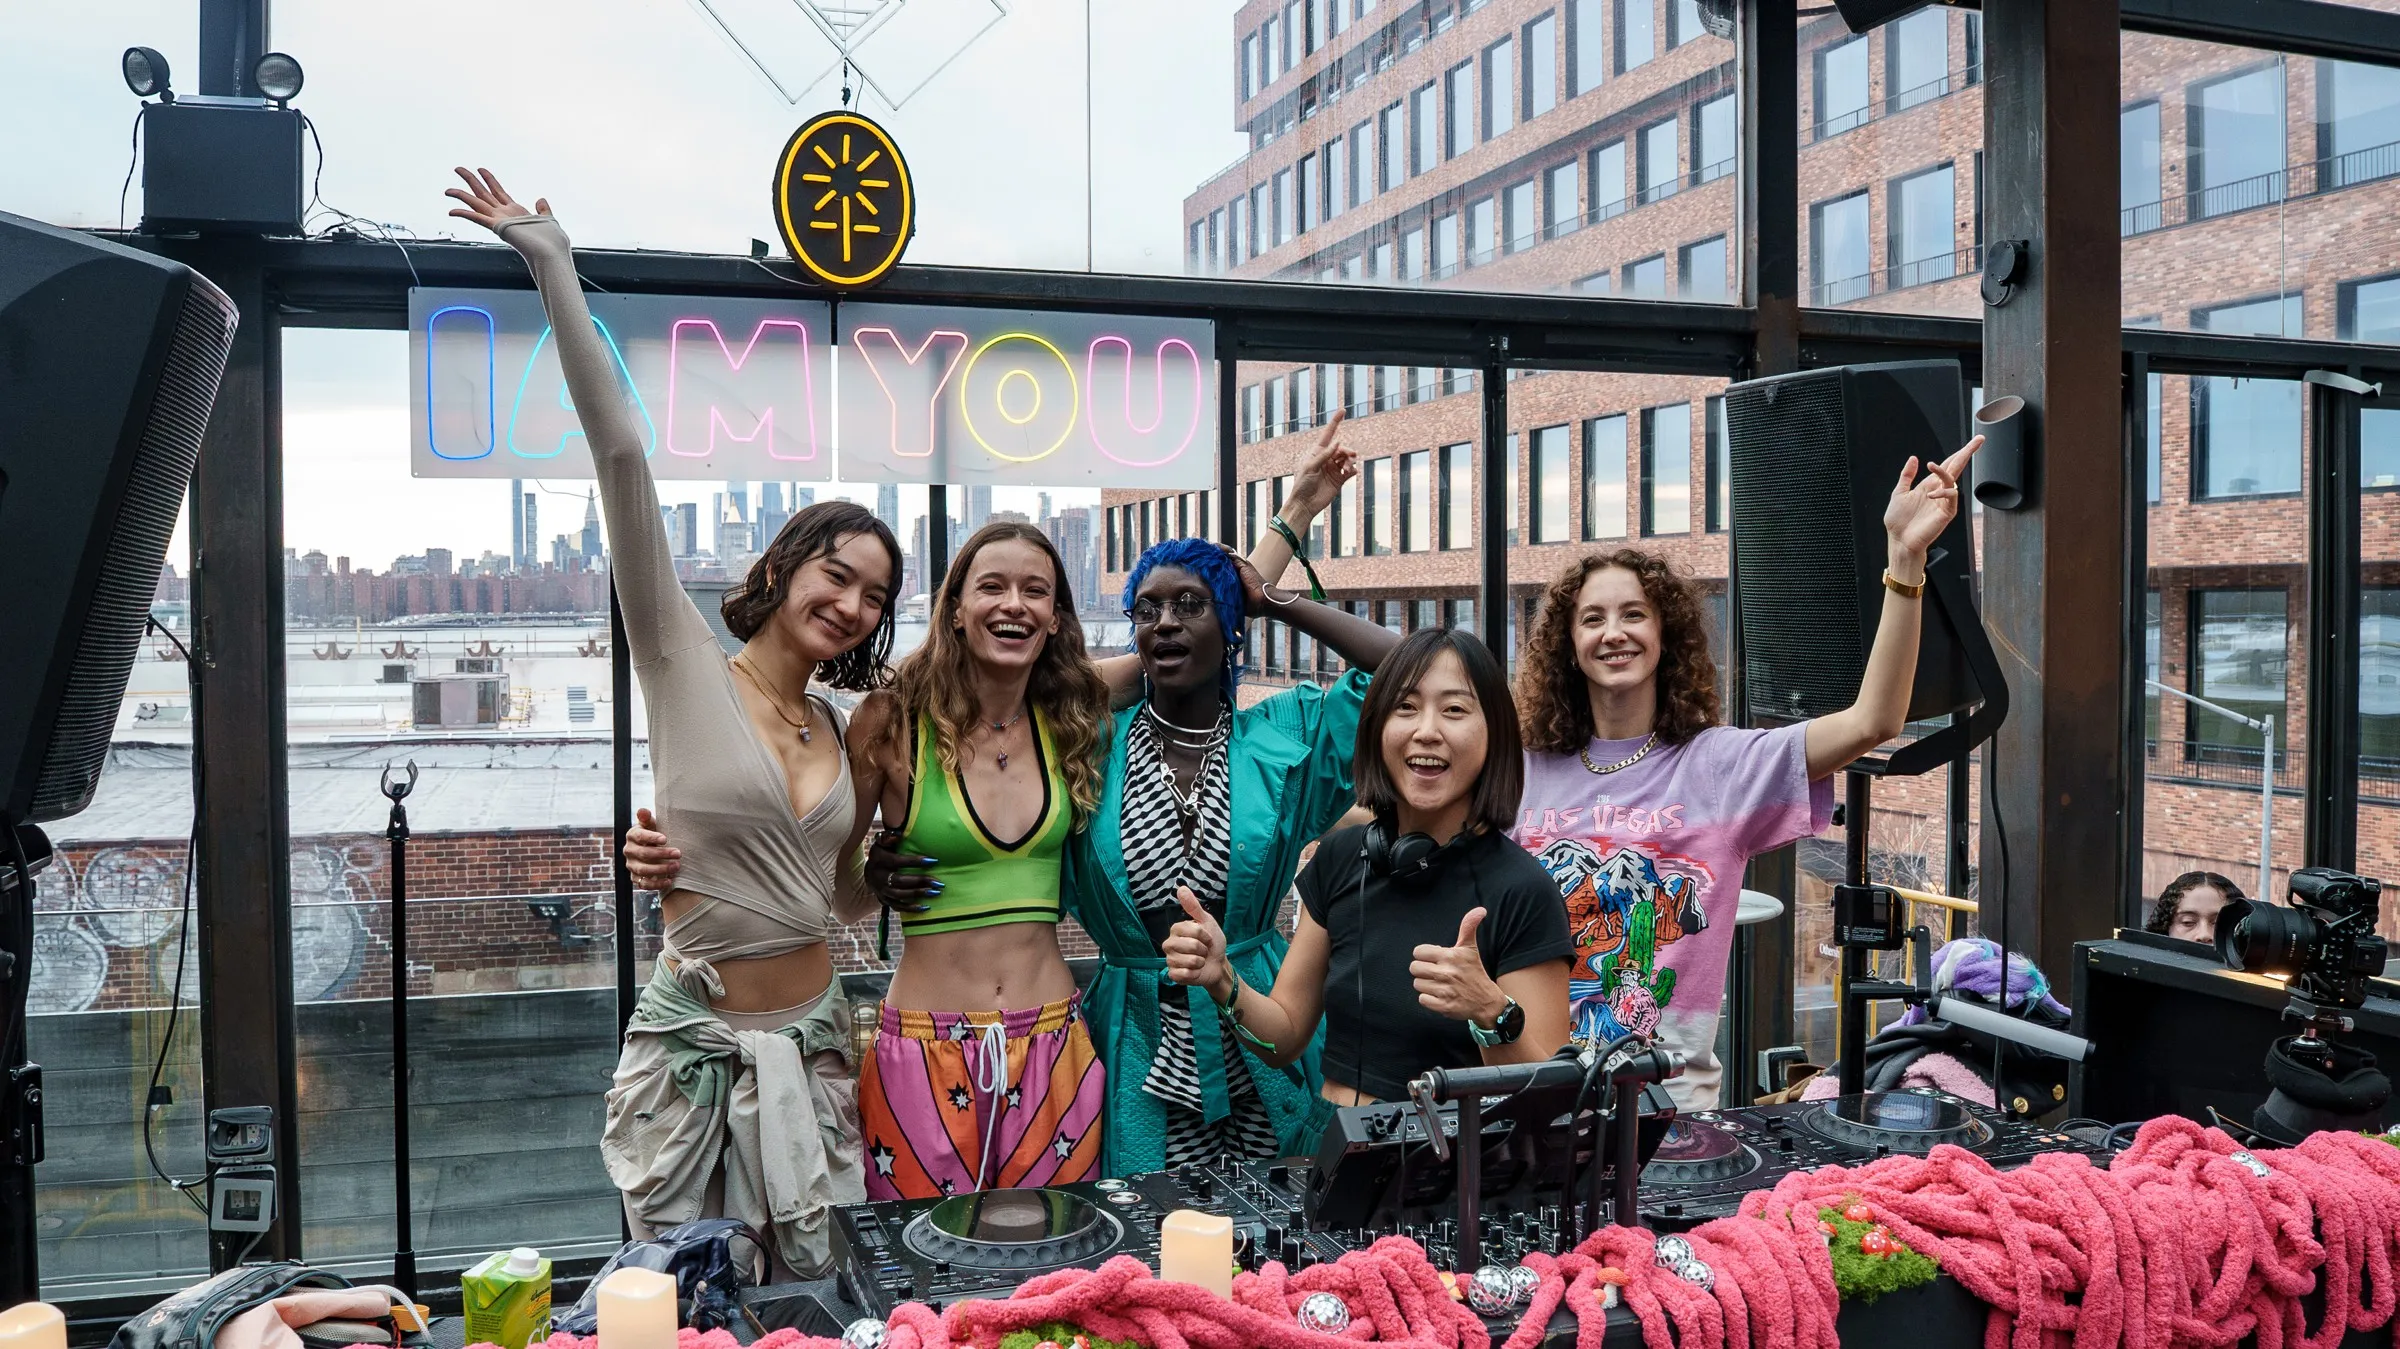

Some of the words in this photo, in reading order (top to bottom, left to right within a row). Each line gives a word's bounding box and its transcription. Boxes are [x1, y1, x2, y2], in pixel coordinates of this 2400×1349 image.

[427, 306, 494, 461] I
[853, 327, 1201, 468] YOU
[1520, 807, 1584, 837] LAS
[1591, 803, 1686, 836] VEGAS
